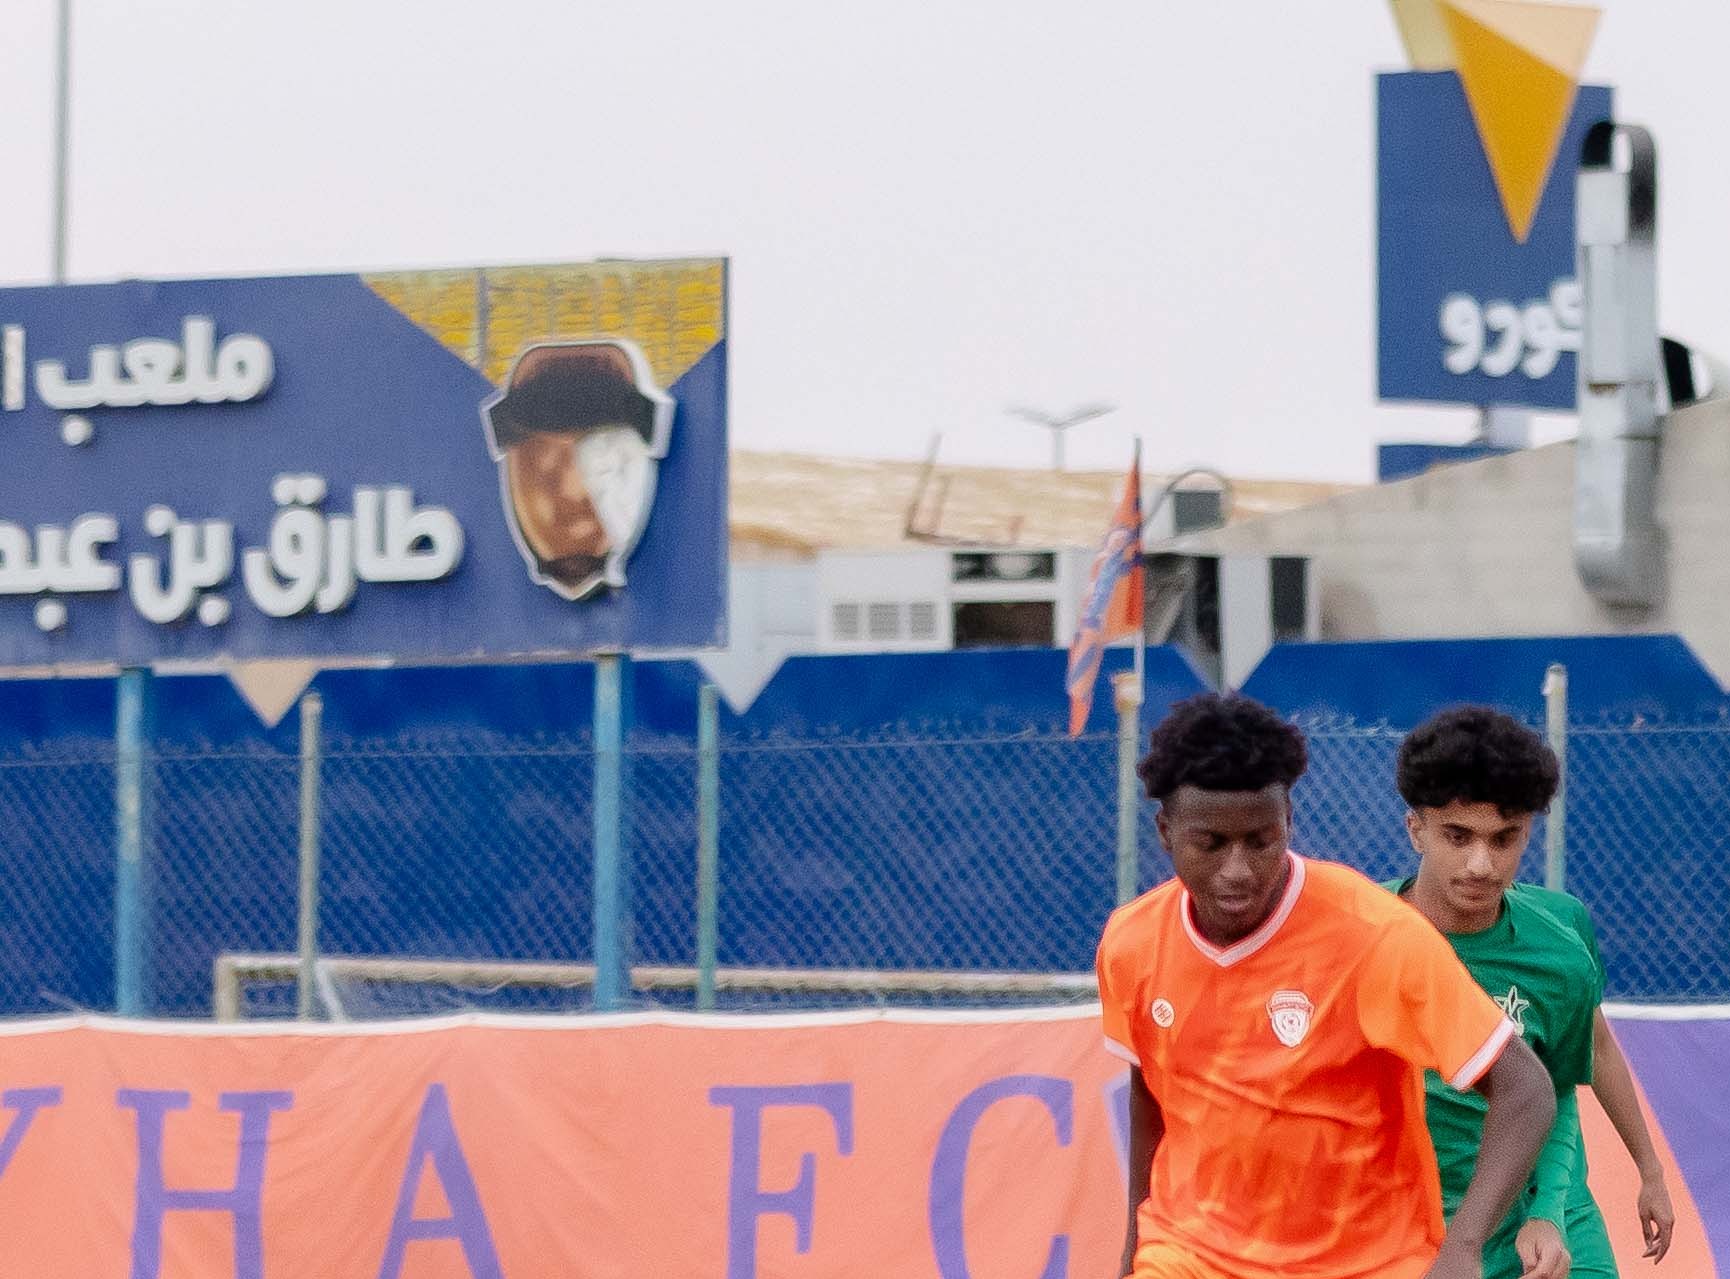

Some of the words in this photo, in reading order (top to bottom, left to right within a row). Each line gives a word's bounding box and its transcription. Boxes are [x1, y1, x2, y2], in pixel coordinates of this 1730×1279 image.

[34, 315, 274, 446] ملعب
[130, 504, 232, 628] بن
[244, 474, 463, 617] طارق
